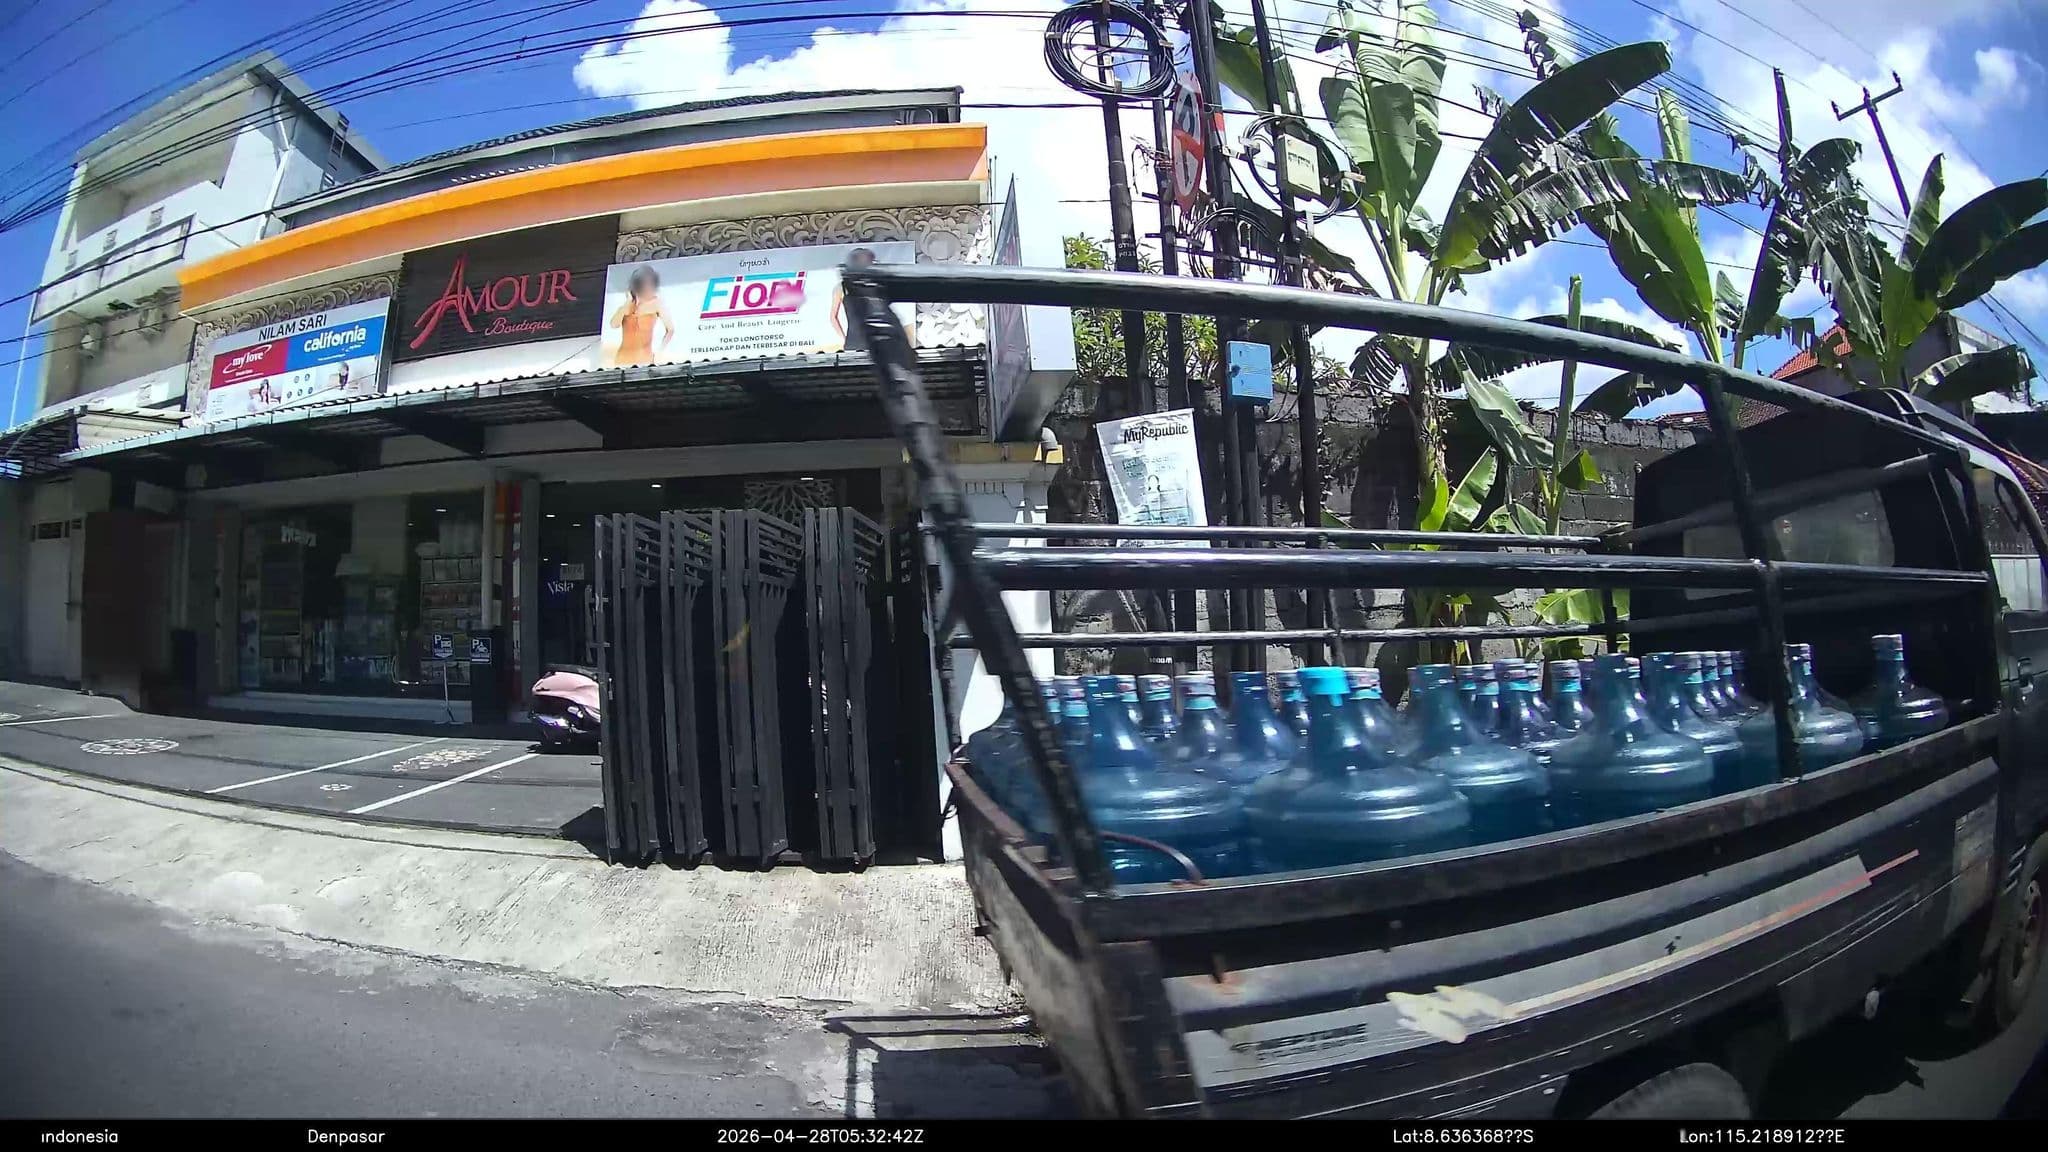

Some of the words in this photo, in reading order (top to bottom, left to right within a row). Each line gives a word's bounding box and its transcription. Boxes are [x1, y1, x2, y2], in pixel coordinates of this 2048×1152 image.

[410, 252, 577, 349] AMOUR
[258, 320, 297, 341] NILAM
[299, 313, 328, 332] SARI
[485, 317, 553, 336] Boutique
[304, 325, 367, 352] california
[690, 345, 735, 353] TERLENGKAP
[753, 340, 788, 349] TERBESAR
[740, 333, 785, 342] LONGTORSO
[1123, 422, 1189, 444] MyRepublic
[547, 579, 574, 594] Vista
[472, 639, 480, 649] P
